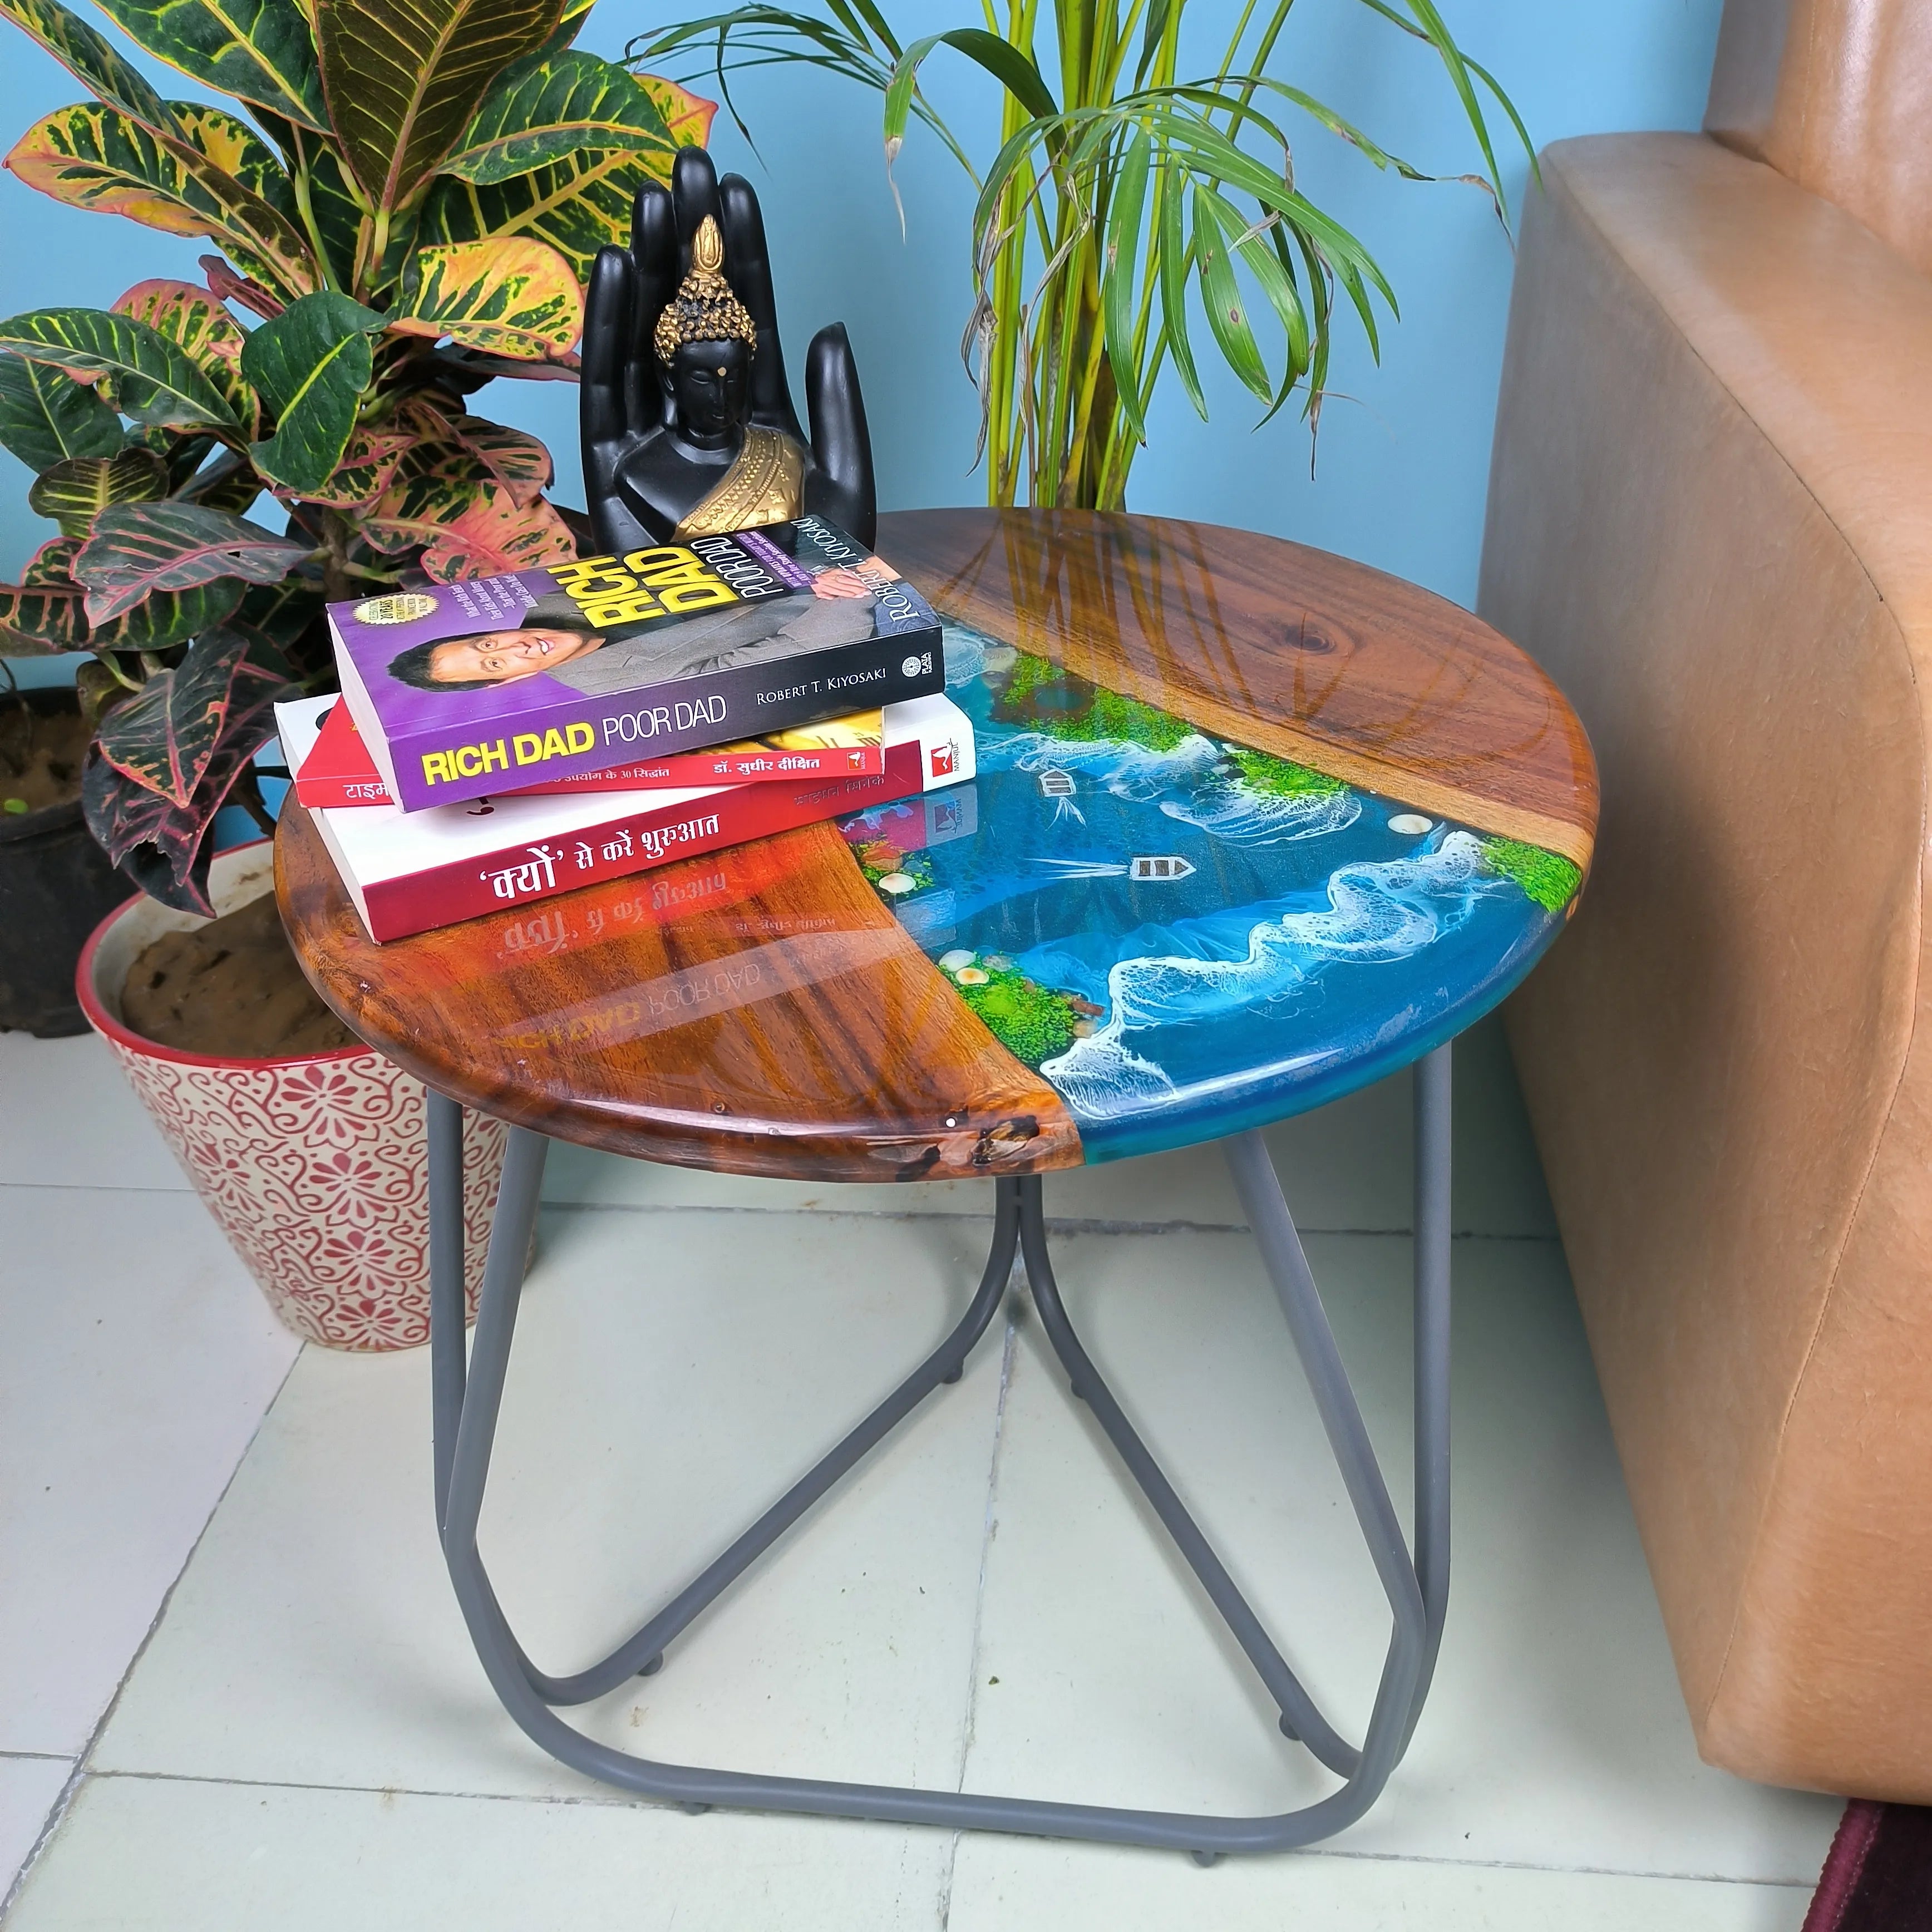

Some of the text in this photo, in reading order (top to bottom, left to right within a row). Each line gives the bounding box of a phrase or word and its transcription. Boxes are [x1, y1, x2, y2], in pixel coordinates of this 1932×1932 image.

[763, 543, 782, 555] Session
[691, 538, 783, 598] POOR DAD
[769, 561, 792, 578] UPDATES
[790, 518, 921, 622] ROBERT T. KIYOSAKI
[492, 584, 506, 593] Poor
[624, 548, 739, 613] DAD
[786, 577, 804, 587] WITH
[455, 593, 470, 602] Rich
[546, 557, 667, 628] RICH
[378, 599, 393, 613] YEARS
[465, 606, 481, 618] What
[482, 602, 498, 611] Kids
[756, 668, 886, 704] ROBERT T. KIYOSAKI
[421, 695, 727, 785] RICH DAD POOR DAD
[606, 770, 617, 779] के
[633, 767, 669, 778] सिद्धांत
[713, 756, 820, 775] डॉ. सुधीर दीक्षित
[574, 841, 595, 870] से
[600, 829, 634, 861] करें
[641, 814, 719, 860] शुरुआत
